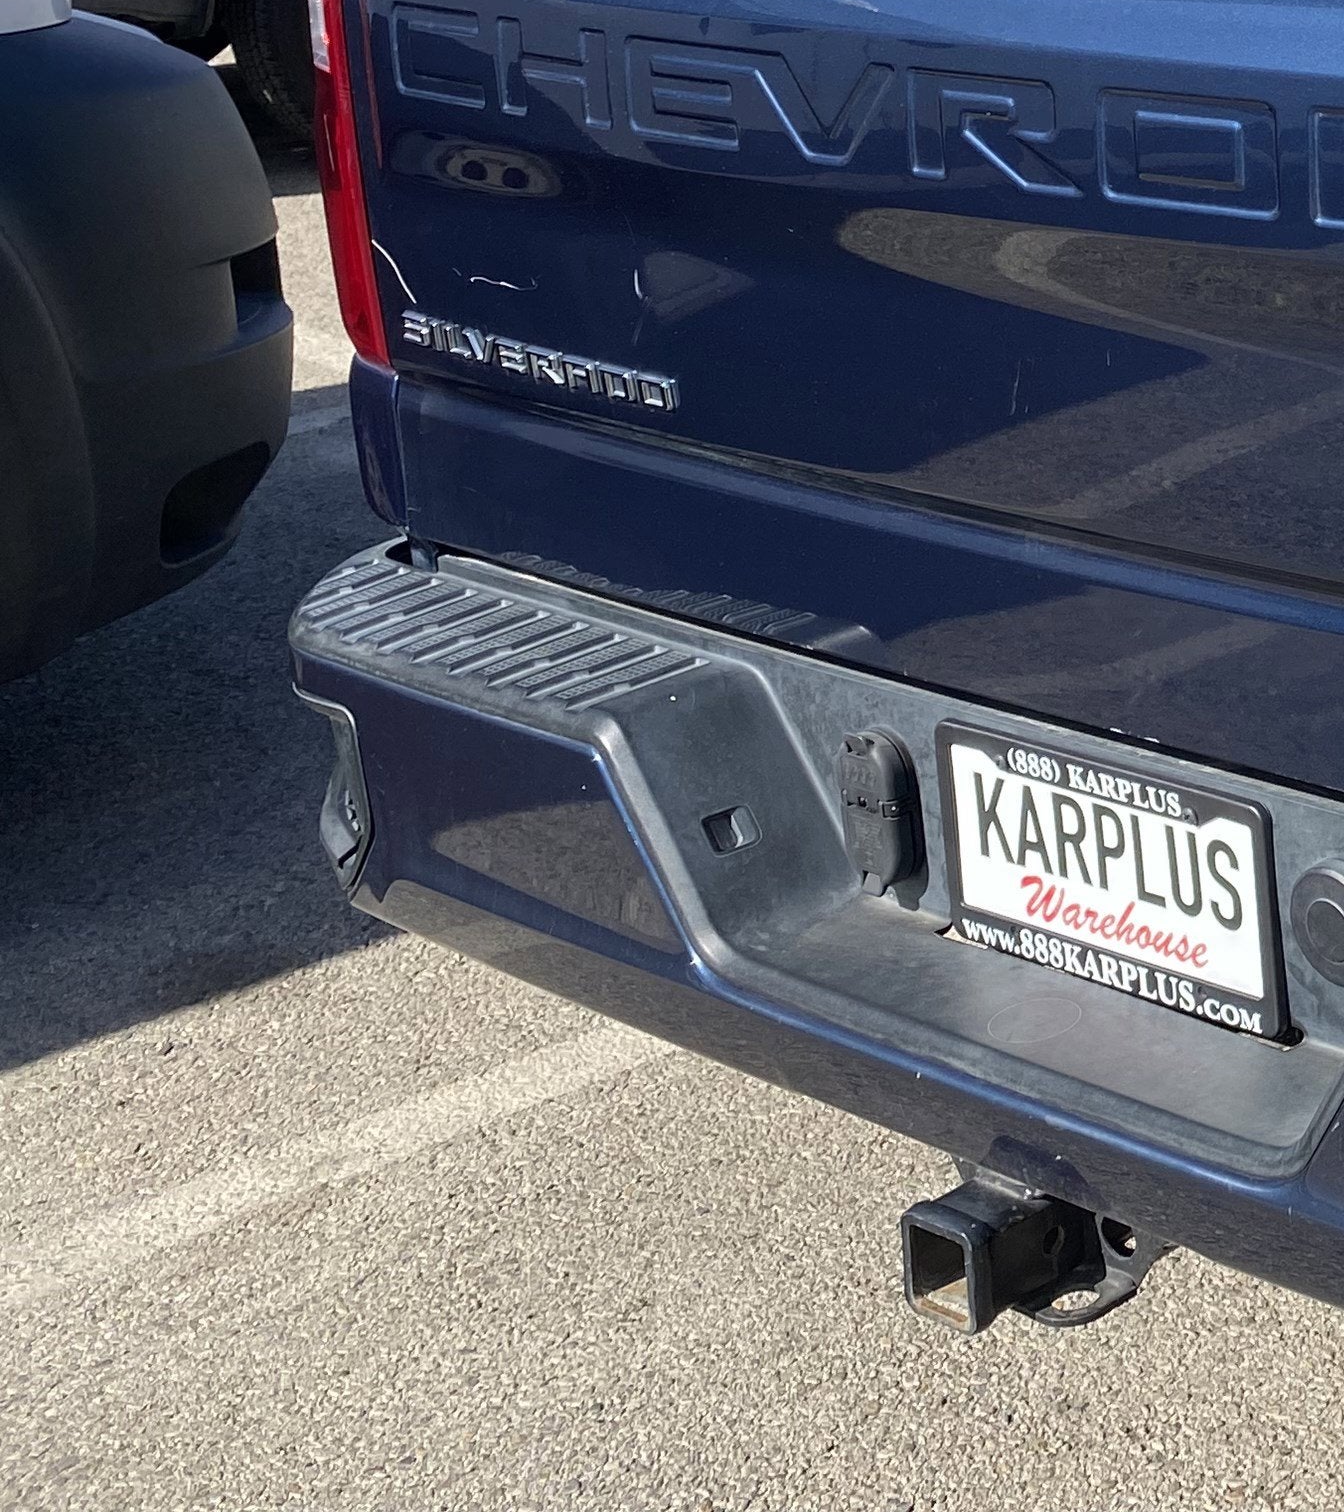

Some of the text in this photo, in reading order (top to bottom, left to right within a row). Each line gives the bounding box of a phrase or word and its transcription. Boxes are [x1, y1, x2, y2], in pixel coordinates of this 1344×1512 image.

[401, 309, 680, 410] SILVERADO
[1006, 747, 1183, 817] (888) KARPLUS
[973, 772, 1243, 931] KARPLUS
[1020, 875, 1209, 968] Warehouse
